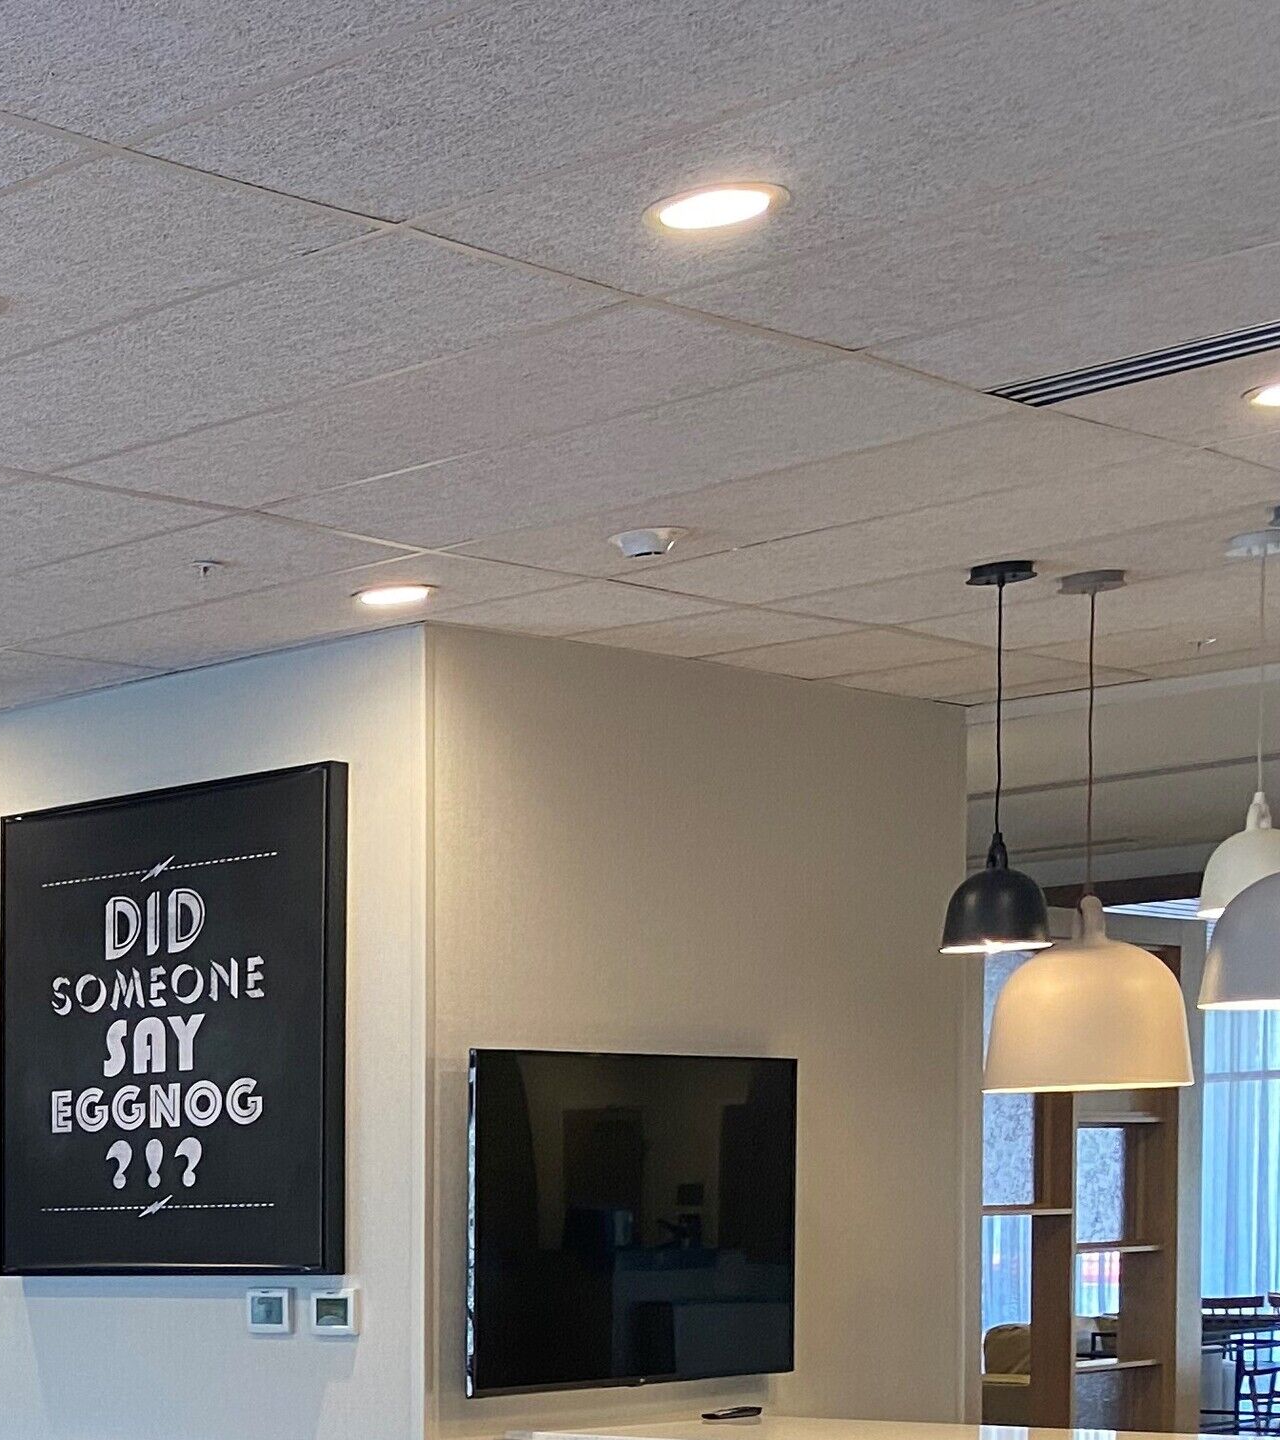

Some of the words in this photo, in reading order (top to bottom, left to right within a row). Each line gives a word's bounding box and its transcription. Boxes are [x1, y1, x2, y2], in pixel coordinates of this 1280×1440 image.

[105, 887, 206, 961] DID
[51, 955, 265, 1016] SOMEONE
[103, 1013, 206, 1078] SAY
[51, 1077, 263, 1134] EGGNOG
[105, 1136, 203, 1190] ?!?
